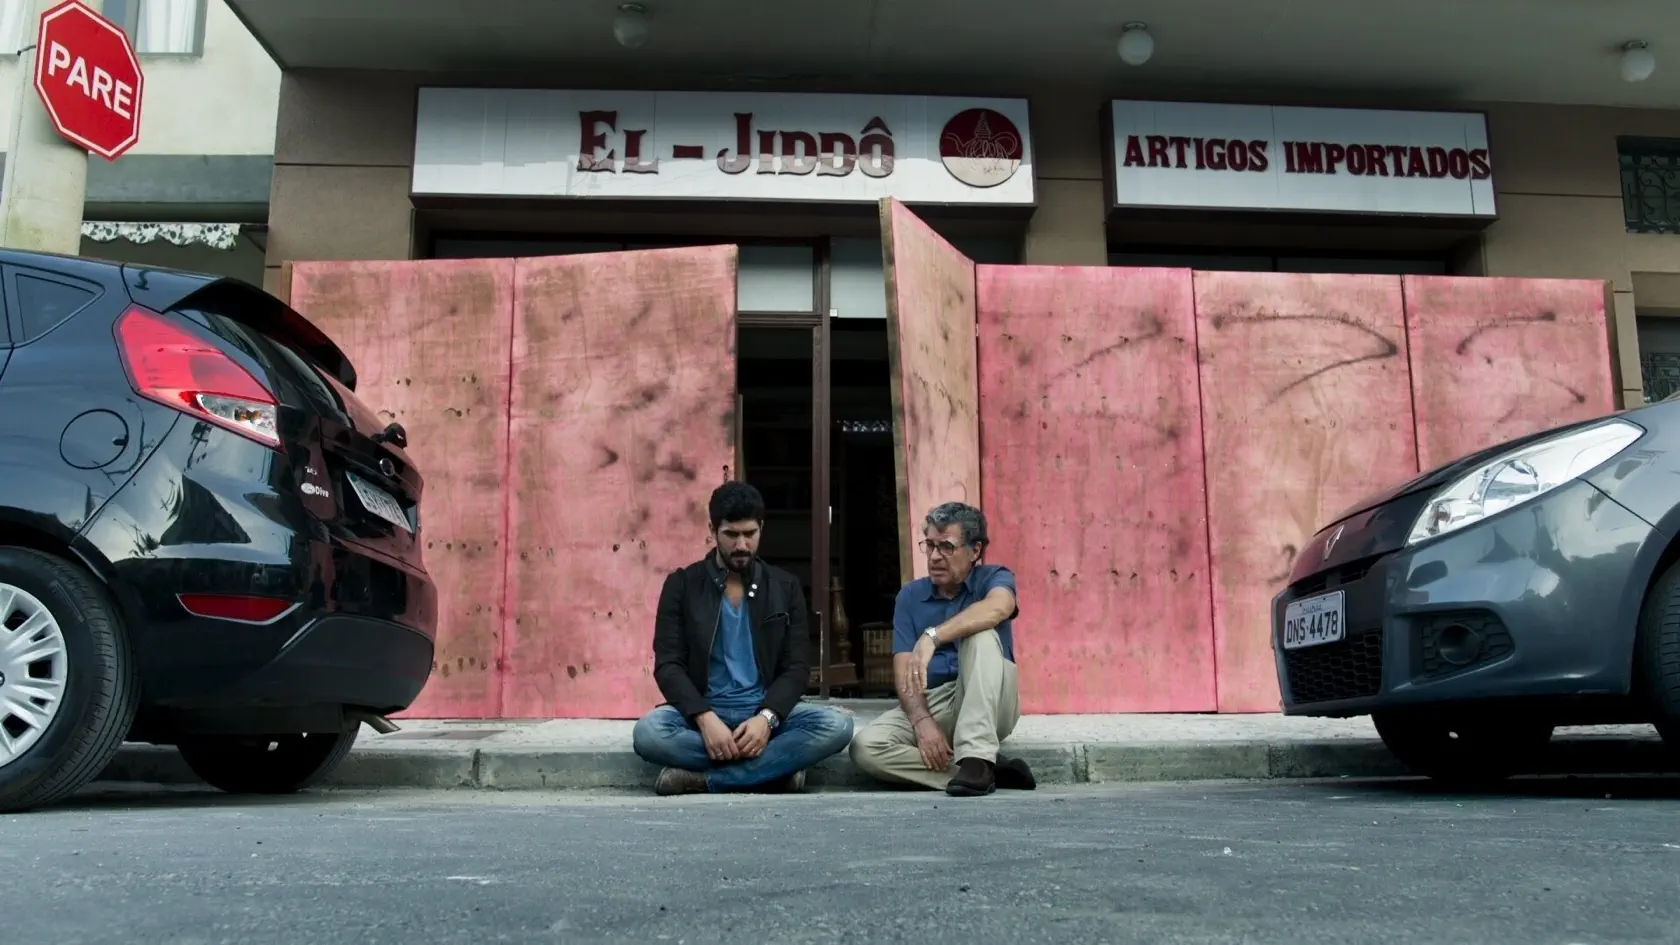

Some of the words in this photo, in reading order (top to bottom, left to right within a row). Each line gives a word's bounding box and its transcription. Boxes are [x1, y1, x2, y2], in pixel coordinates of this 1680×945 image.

[48, 40, 133, 120] PARE
[576, 110, 659, 174] EL
[716, 112, 895, 179] JIDDÔ
[1123, 135, 1268, 172] ARTIGOS
[1282, 141, 1491, 180] IMPORTADOS
